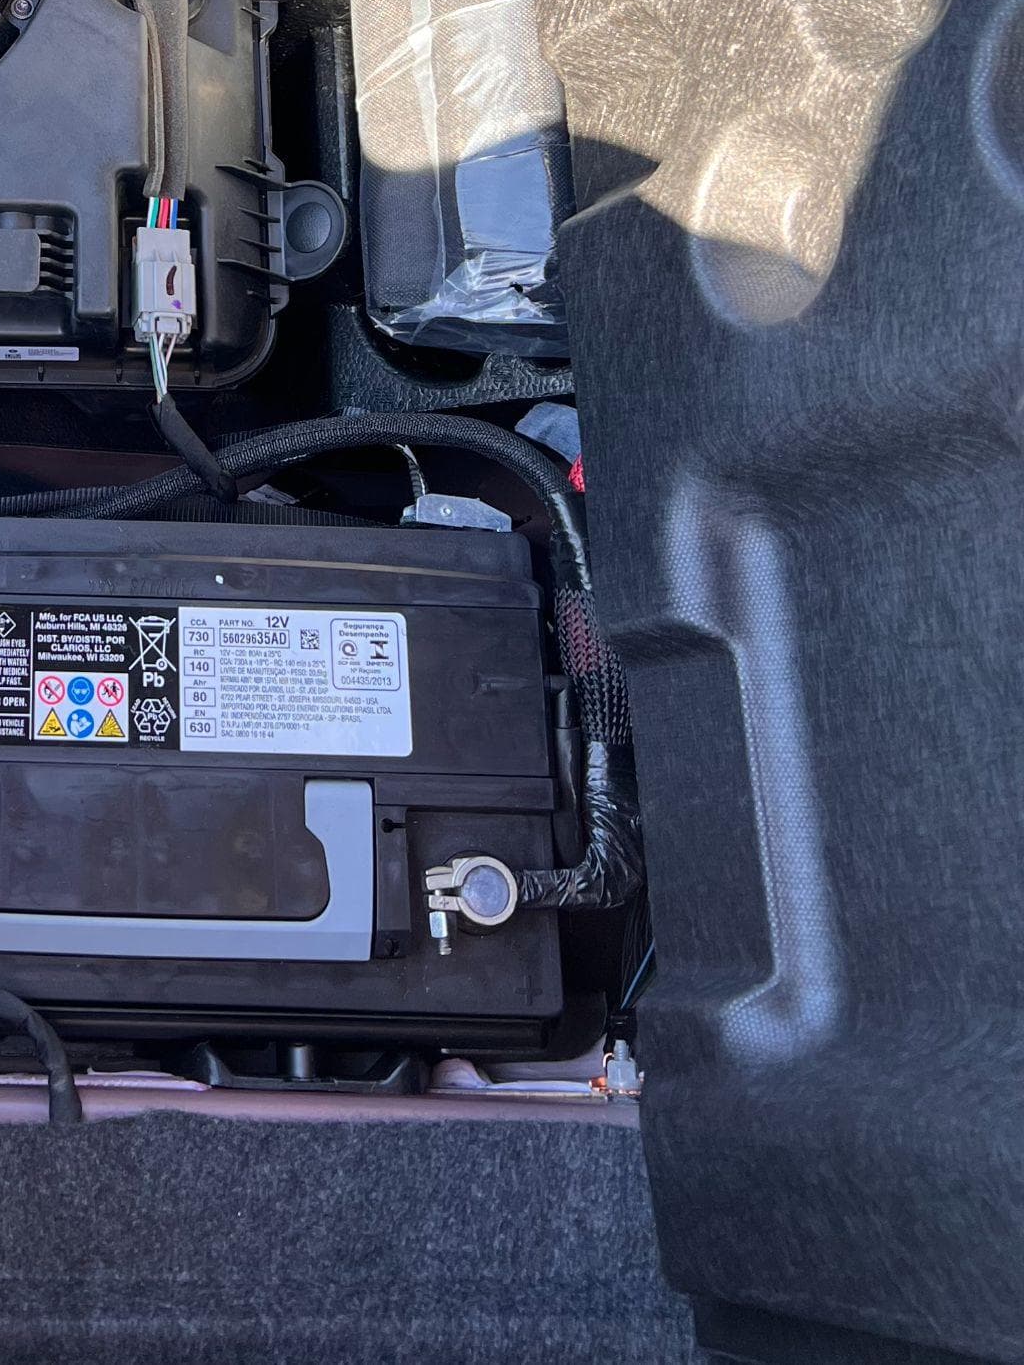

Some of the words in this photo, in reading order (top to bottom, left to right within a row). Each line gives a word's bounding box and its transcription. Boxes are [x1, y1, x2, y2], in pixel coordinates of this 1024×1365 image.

[39, 612, 58, 622] Mfg.
[59, 613, 72, 621] for
[73, 613, 91, 622] FCA
[92, 614, 105, 622] US
[106, 614, 124, 622] LLC
[265, 616, 289, 628] 12V
[35, 621, 66, 630] Auburn
[67, 622, 88, 632] Hills,
[90, 623, 100, 631] MI
[219, 619, 239, 627] PART
[343, 622, 384, 631] Segurança
[189, 631, 209, 642] 730
[223, 632, 287, 645] 56029635AD
[339, 630, 389, 638] Desempenho
[37, 634, 59, 643] DIST.
[61, 635, 104, 644] BY/DISTR.
[106, 636, 125, 645] POR
[51, 644, 93, 653] CLARIOS,
[94, 644, 111, 653] LLC
[37, 652, 85, 662] Milwaukee,
[86, 653, 98, 661] WI
[190, 662, 209, 672] 140
[142, 671, 165, 688] Pb
[193, 691, 207, 702] 80
[3, 697, 27, 707] OPEN.
[147, 712, 158, 720] Pb
[195, 709, 206, 717] EN
[190, 722, 211, 733] 630
